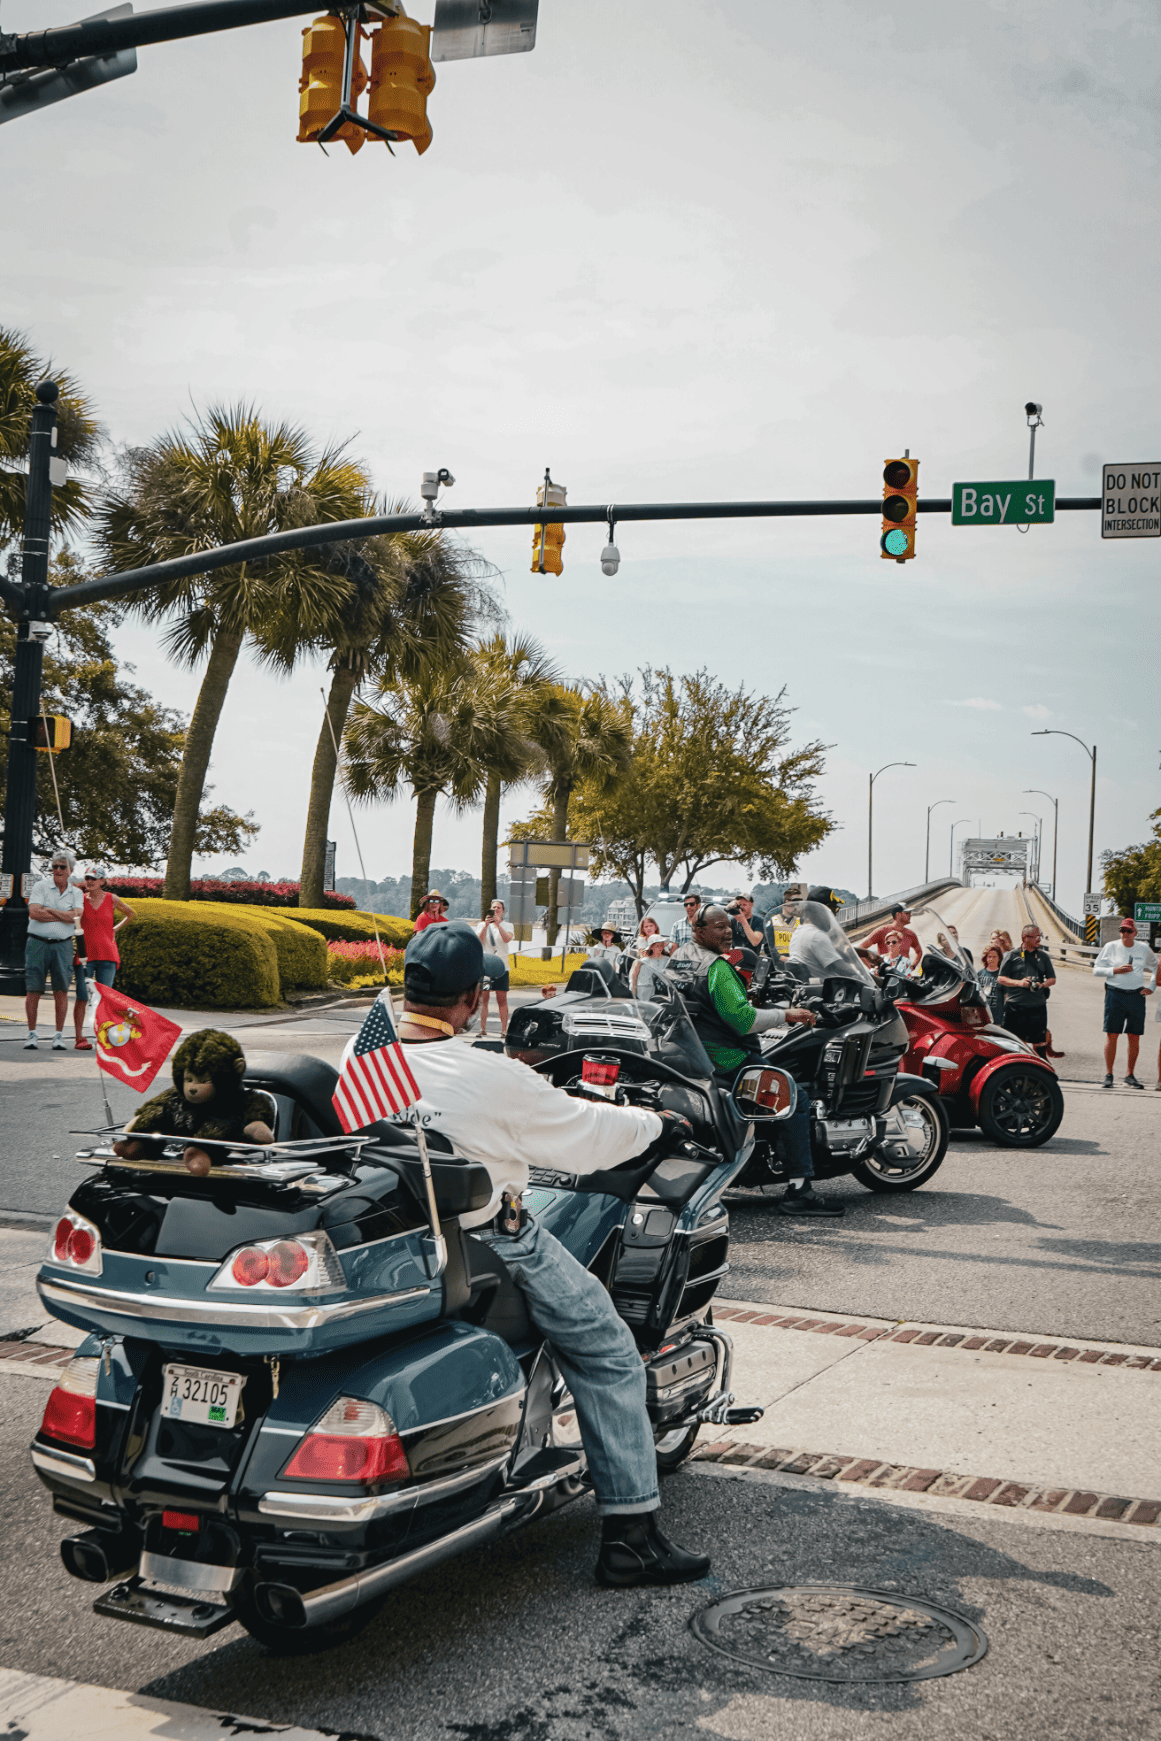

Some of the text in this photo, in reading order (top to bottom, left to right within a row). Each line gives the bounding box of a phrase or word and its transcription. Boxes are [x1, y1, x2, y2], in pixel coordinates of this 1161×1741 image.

[1105, 472, 1161, 491] DO NOT
[960, 488, 1046, 524] Bay St
[1105, 496, 1160, 515] BLOCK
[1104, 518, 1159, 532] INTERSECTION
[1085, 904, 1099, 912] 35
[184, 1368, 223, 1381] South Carolina
[182, 1378, 229, 1406] 32105
